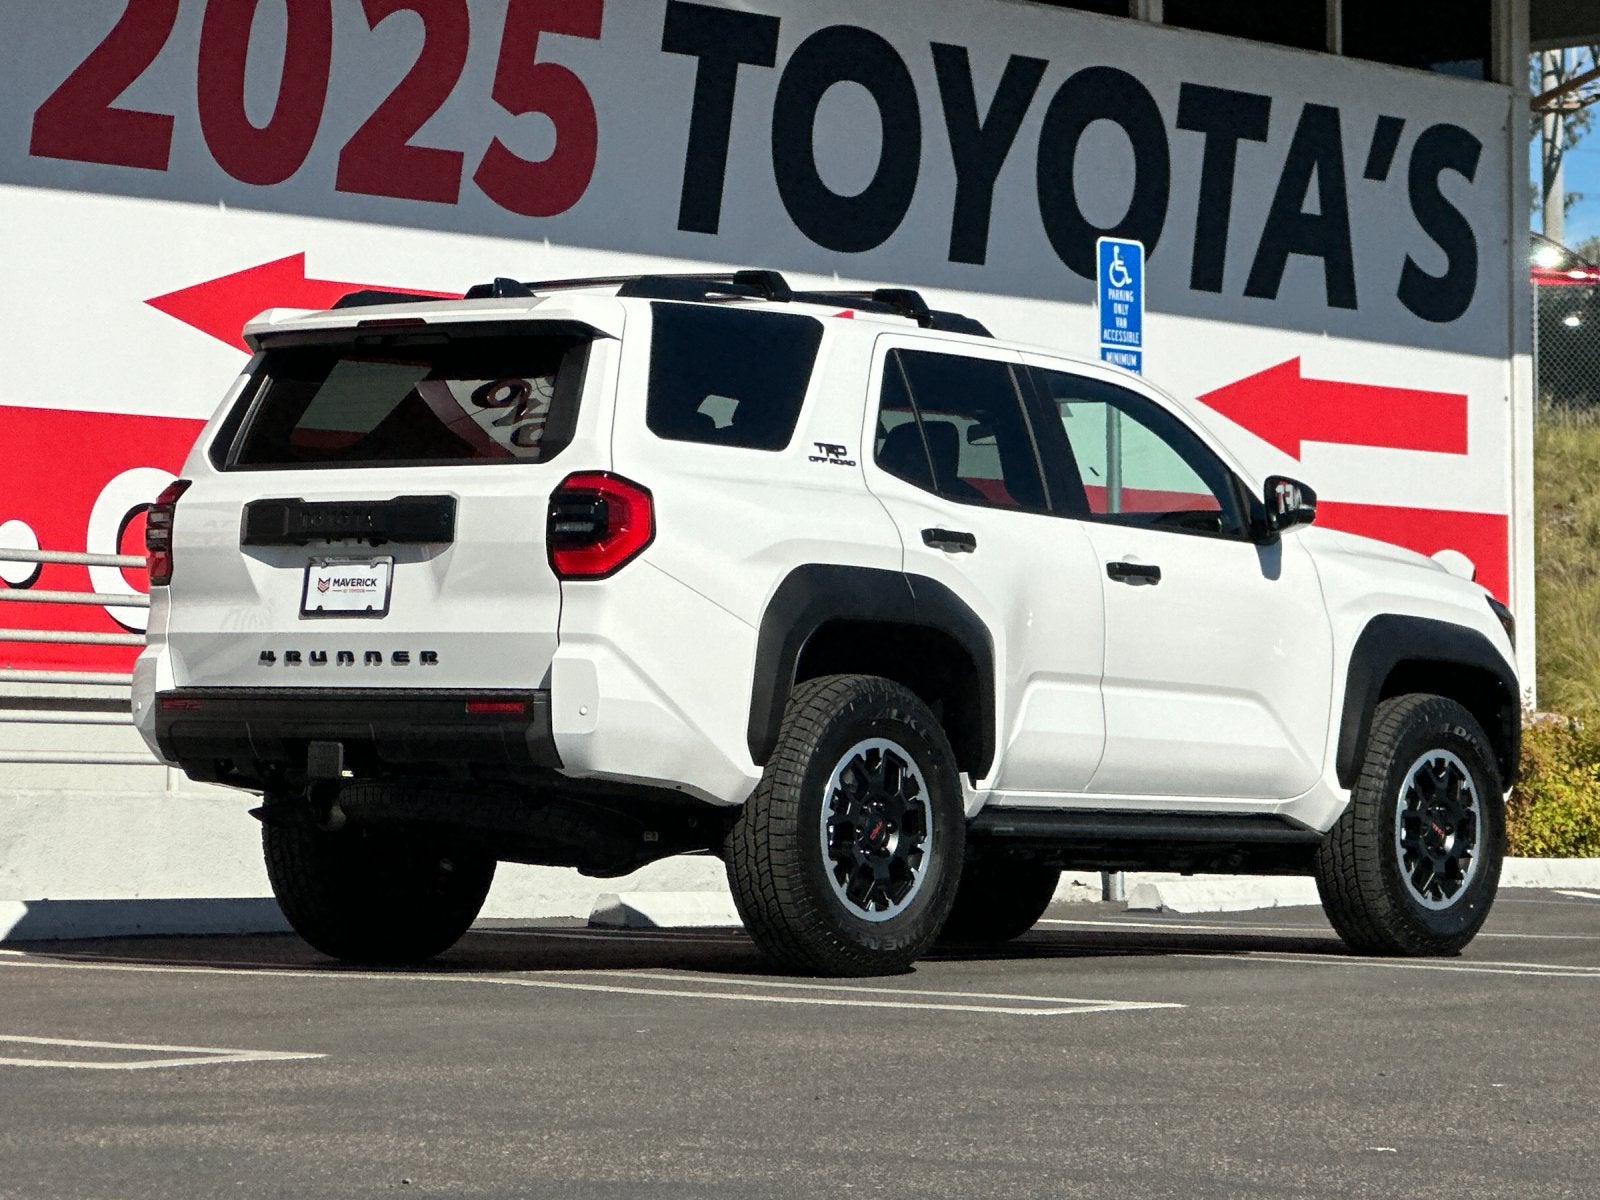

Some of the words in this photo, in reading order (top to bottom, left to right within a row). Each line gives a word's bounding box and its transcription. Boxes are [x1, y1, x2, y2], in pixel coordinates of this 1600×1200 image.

[31, 0, 602, 216] 2025
[661, 0, 1482, 323] TOYOTA'S
[1108, 288, 1133, 302] PARKING
[1113, 303, 1128, 315] ONLY
[1115, 317, 1127, 328] VAN
[1103, 329, 1139, 343] ACCESSIBLE
[1106, 352, 1136, 366] MINIMUM
[813, 442, 847, 458] TRD
[332, 578, 378, 588] MAVERICK
[258, 650, 440, 665] 4RUNNER
